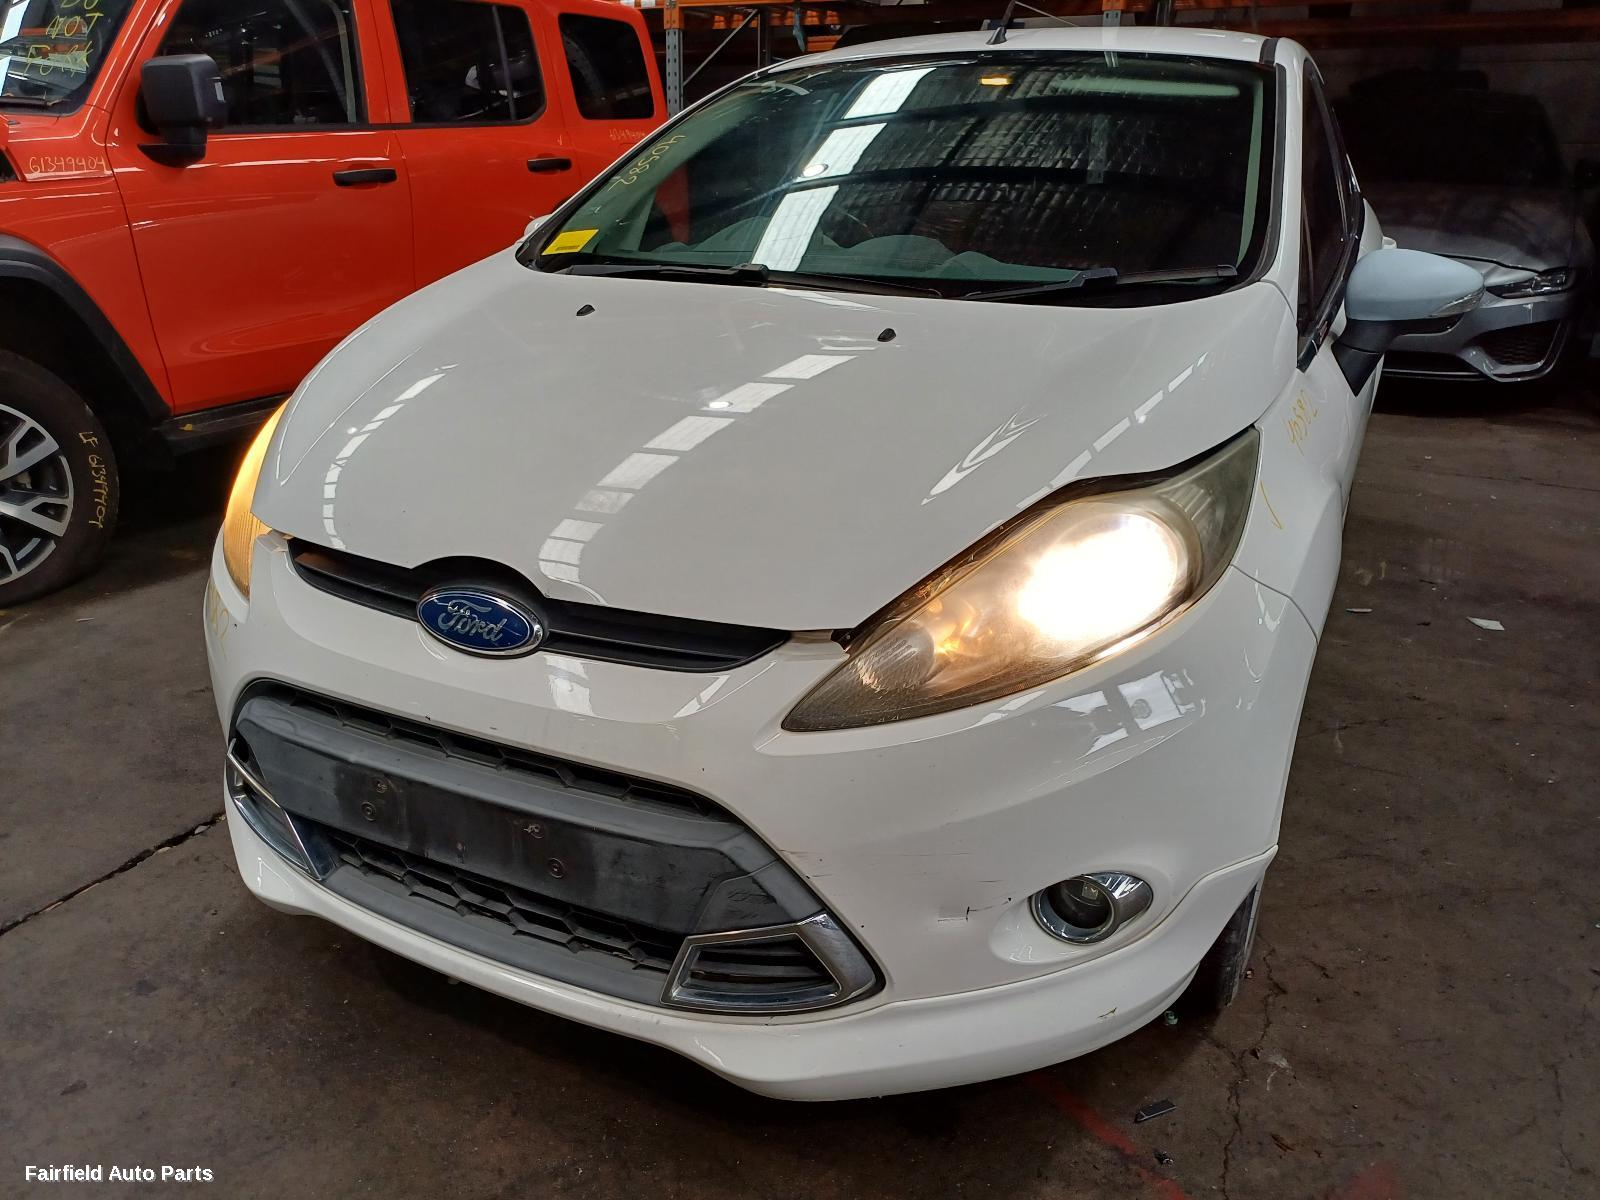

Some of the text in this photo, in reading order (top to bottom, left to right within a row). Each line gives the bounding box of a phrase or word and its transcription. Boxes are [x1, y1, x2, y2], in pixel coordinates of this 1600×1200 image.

[46, 12, 104, 39] NOT
[29, 153, 108, 174] 61349404
[79, 431, 98, 448] LF
[437, 599, 507, 642] Ford
